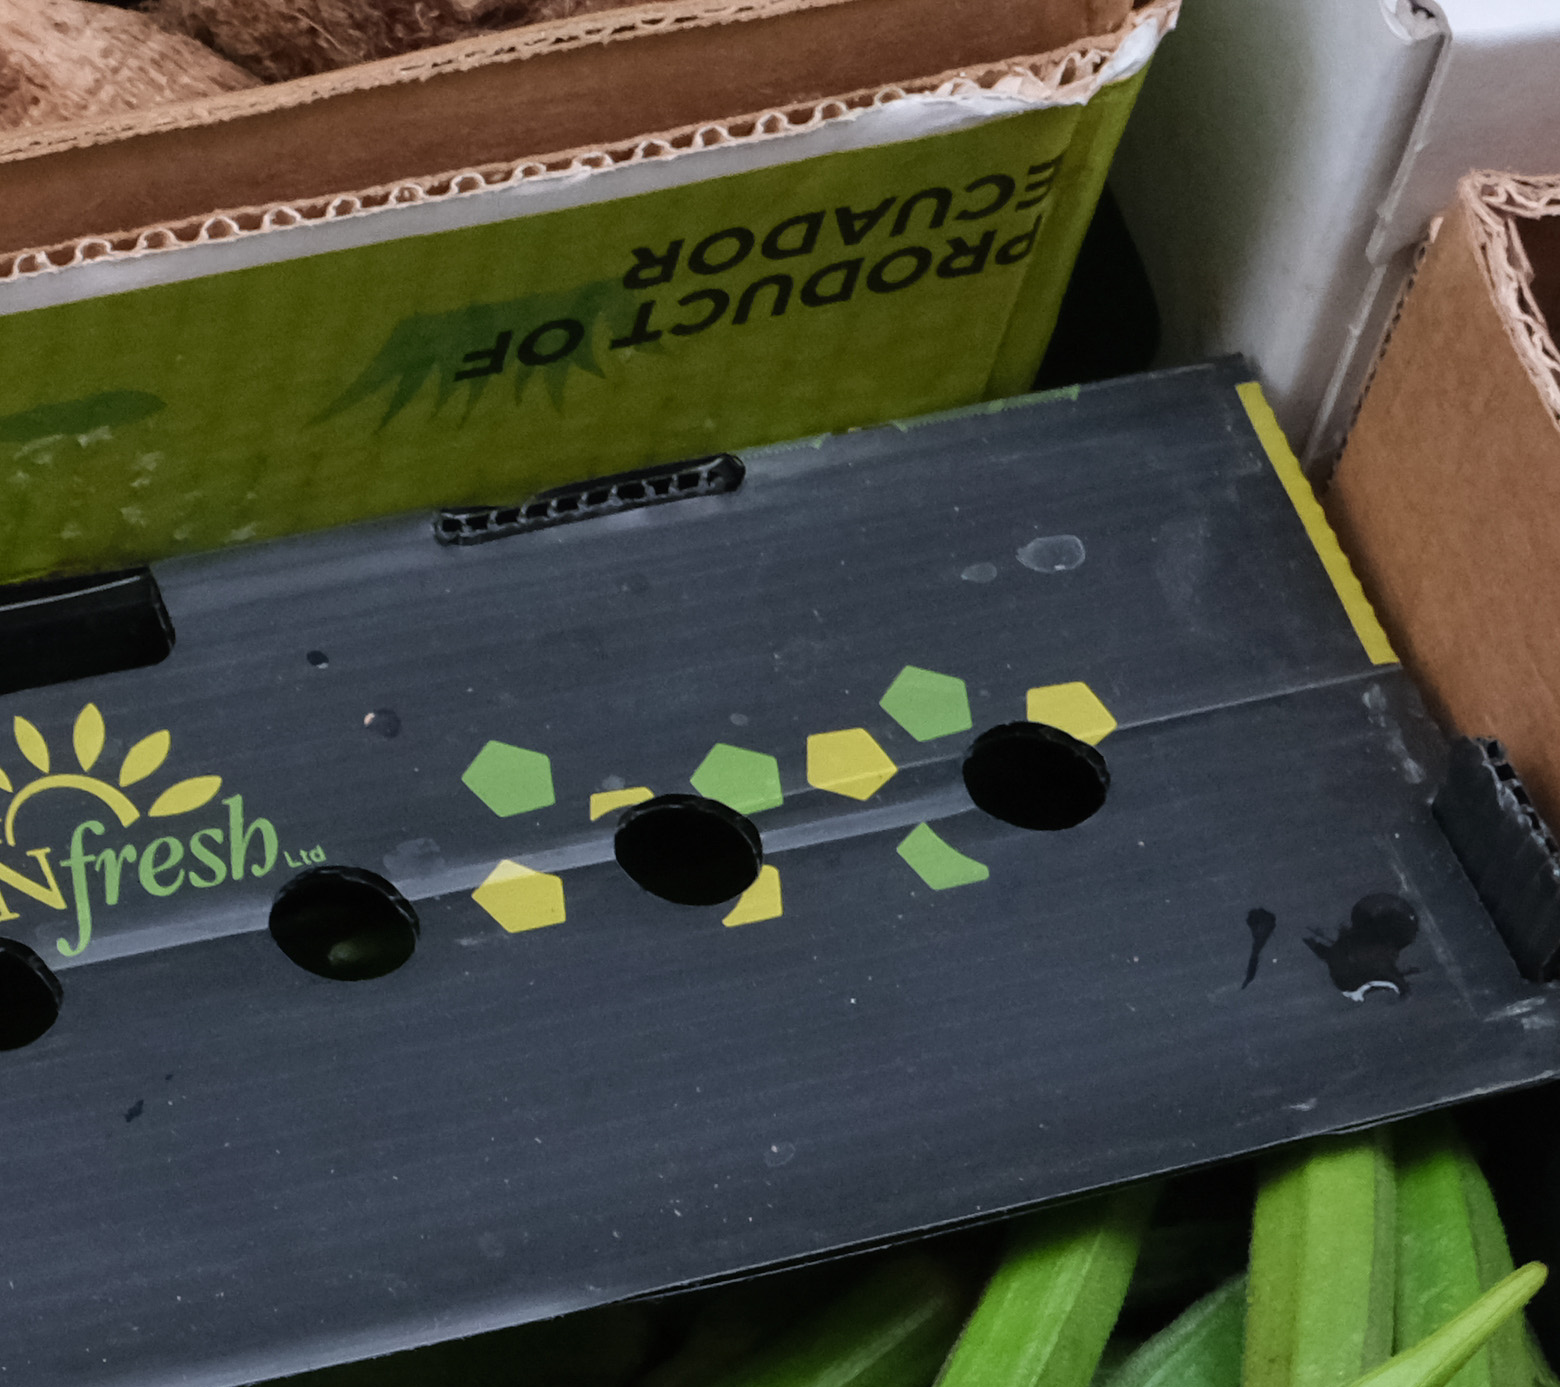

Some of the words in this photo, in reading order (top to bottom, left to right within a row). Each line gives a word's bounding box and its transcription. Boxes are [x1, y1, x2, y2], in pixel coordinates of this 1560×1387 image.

[621, 152, 1068, 290] ECUADOR
[608, 217, 1040, 355] PRODUCT
[453, 318, 586, 384] OF
[284, 845, 327, 869] Ltd
